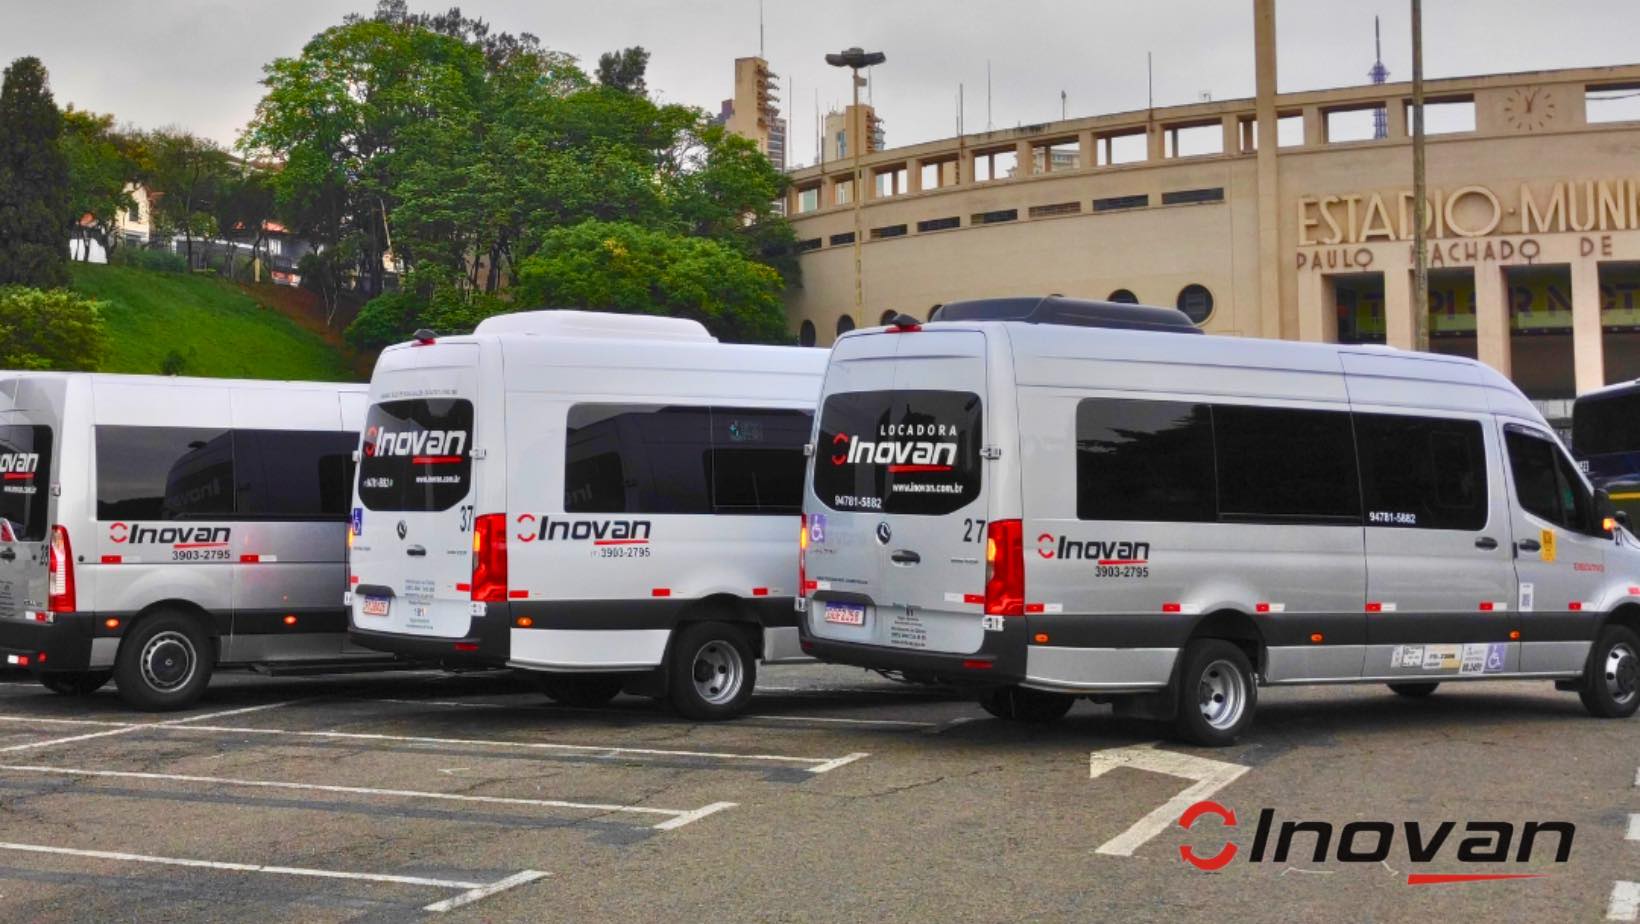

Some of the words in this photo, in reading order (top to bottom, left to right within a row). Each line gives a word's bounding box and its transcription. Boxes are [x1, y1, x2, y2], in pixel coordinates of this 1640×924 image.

[1299, 185, 1501, 245] ESTADIO
[1520, 179, 1640, 233] MUNI
[1296, 248, 1374, 270] PAULO
[1408, 239, 1540, 267] ACHADO
[1580, 236, 1613, 257] DE
[375, 426, 467, 457] Inovan
[880, 424, 957, 436] LOCADORA
[847, 435, 958, 465] Inovan
[892, 482, 964, 494] www.inovan.com.br
[460, 505, 473, 532] 37
[538, 516, 652, 540] Inovan
[963, 518, 986, 543] 27
[129, 524, 231, 544] Inovan
[172, 550, 231, 560] 3903-2795
[601, 547, 651, 557] 3903-2795
[1057, 535, 1150, 560] Inovan
[1095, 565, 1149, 577] 3903-2795
